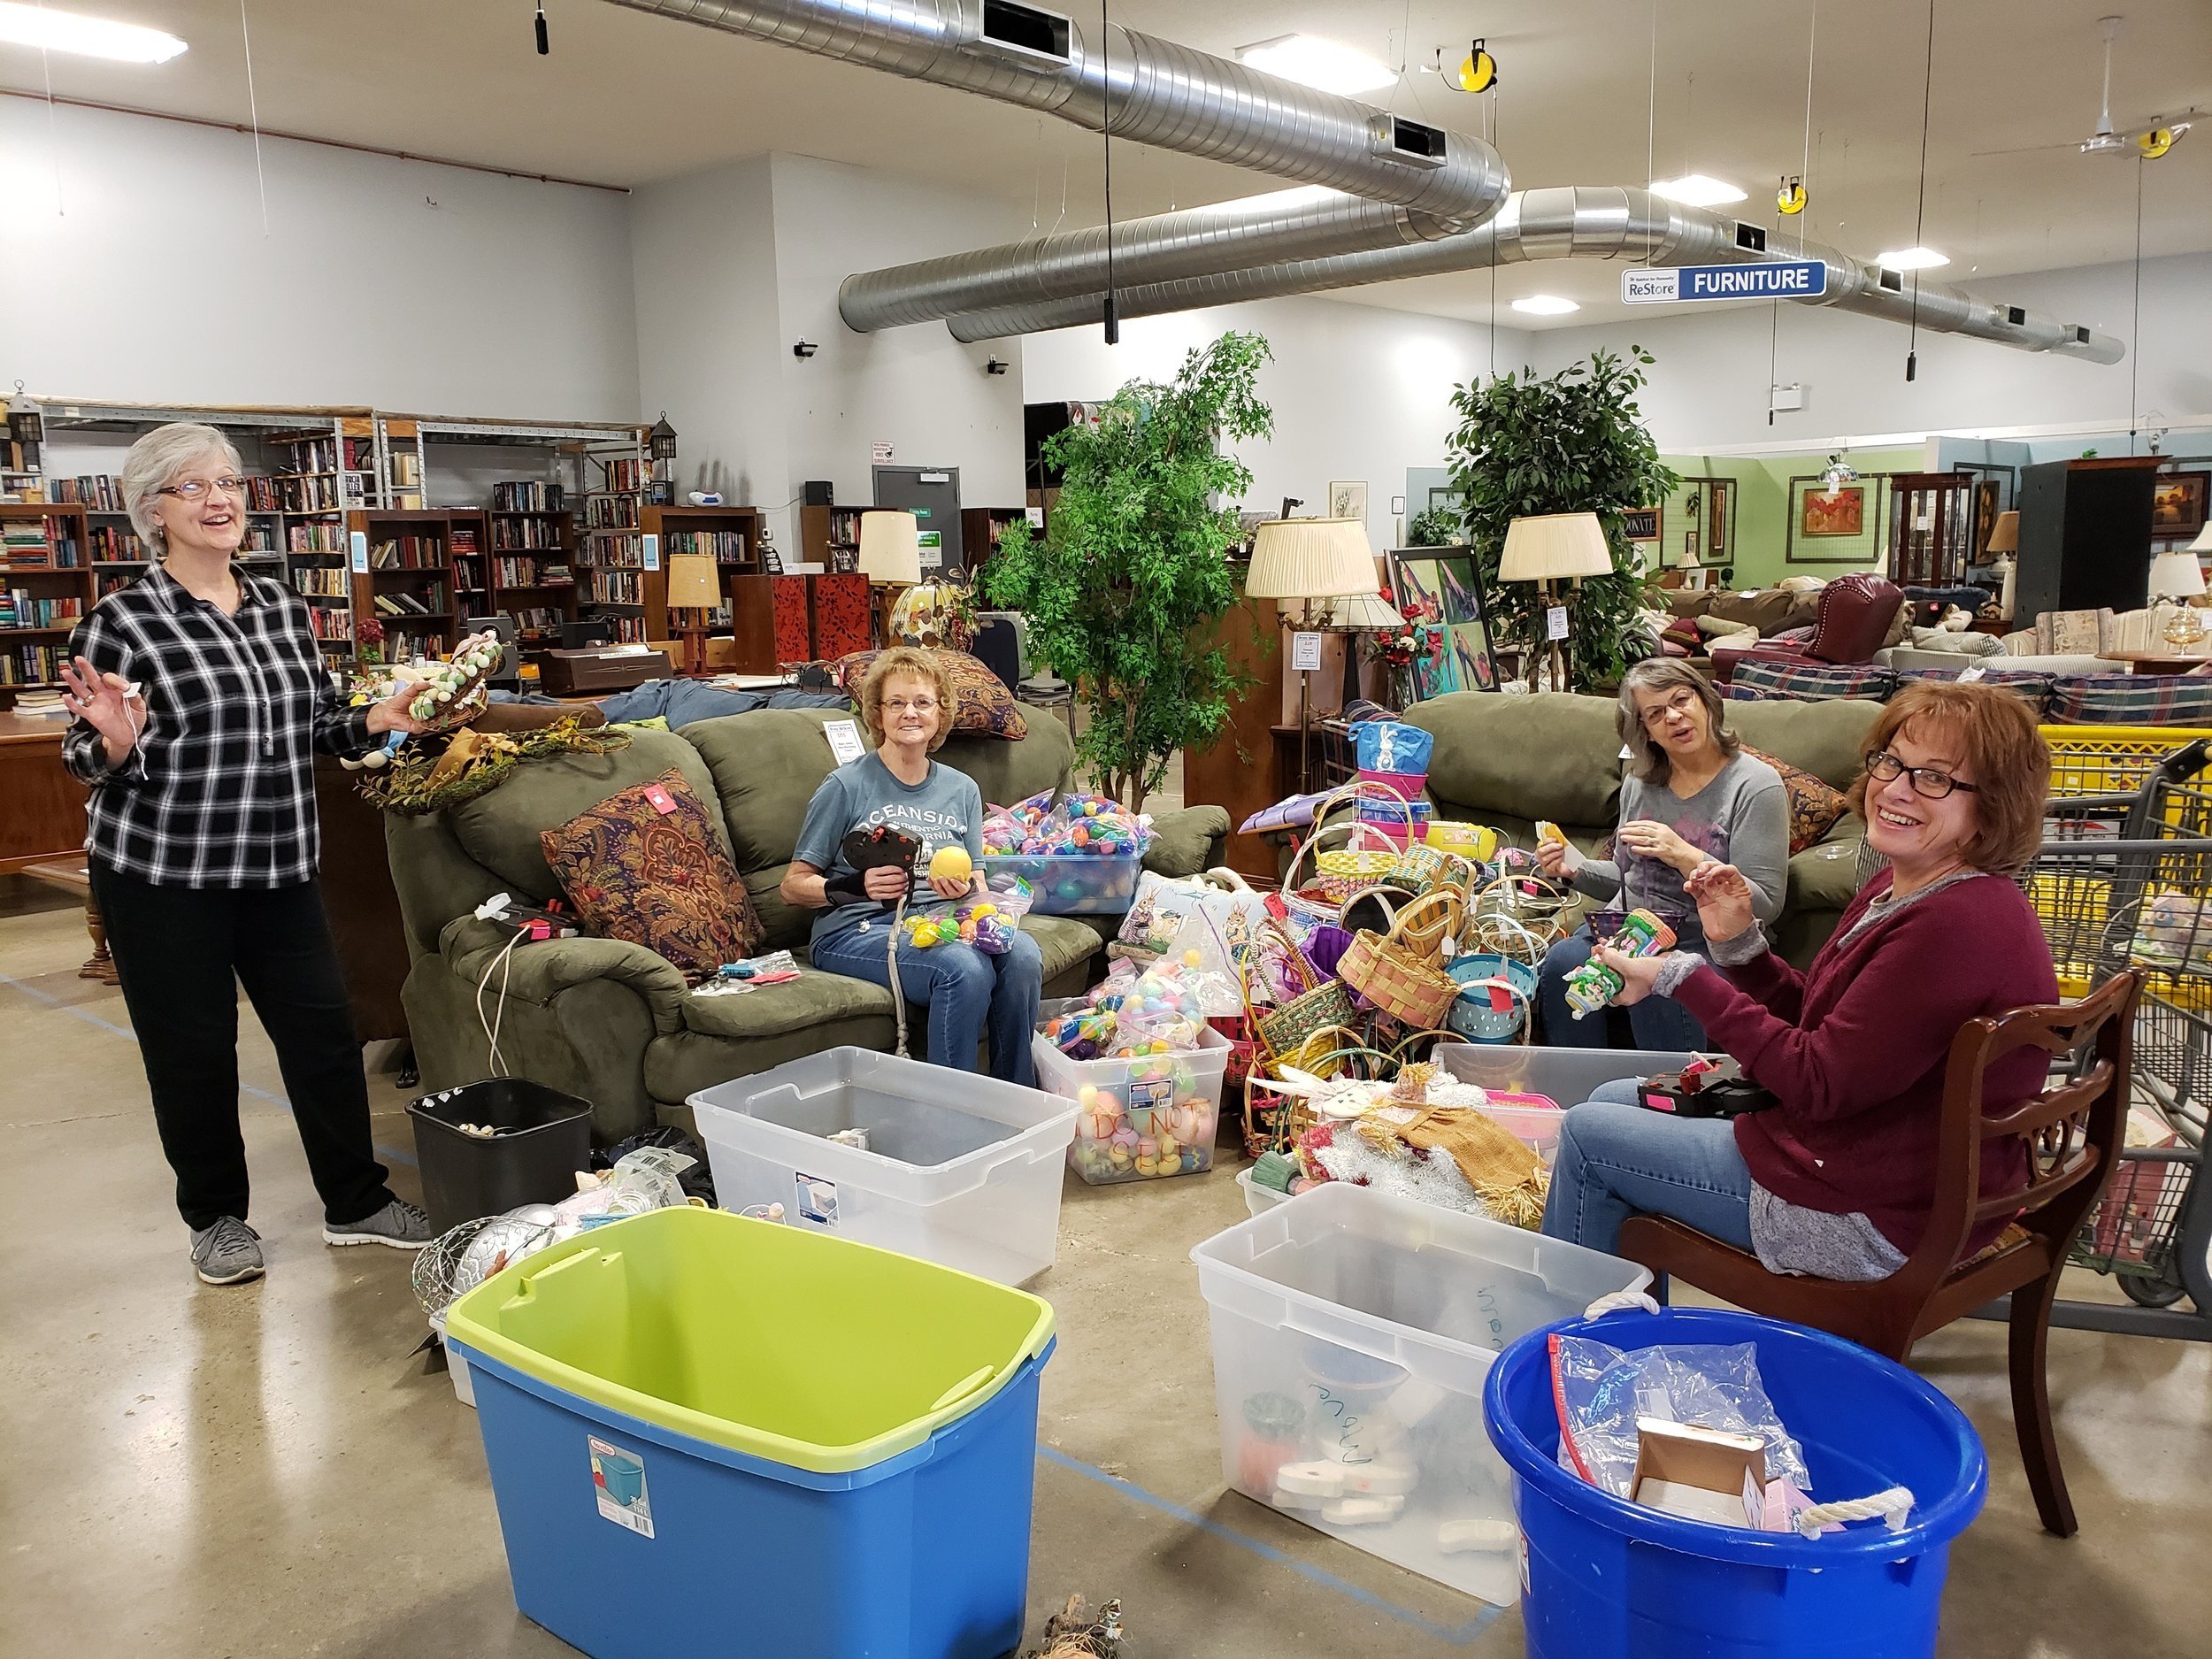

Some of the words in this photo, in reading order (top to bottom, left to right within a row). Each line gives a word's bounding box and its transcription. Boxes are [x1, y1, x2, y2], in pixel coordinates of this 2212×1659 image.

[1629, 283, 1674, 296] ReStore
[1694, 269, 1809, 293] FURNITURE
[1090, 1113, 1134, 1140] DO
[1150, 1098, 1210, 1135] NOT
[592, 1440, 614, 1455] Sterilite
